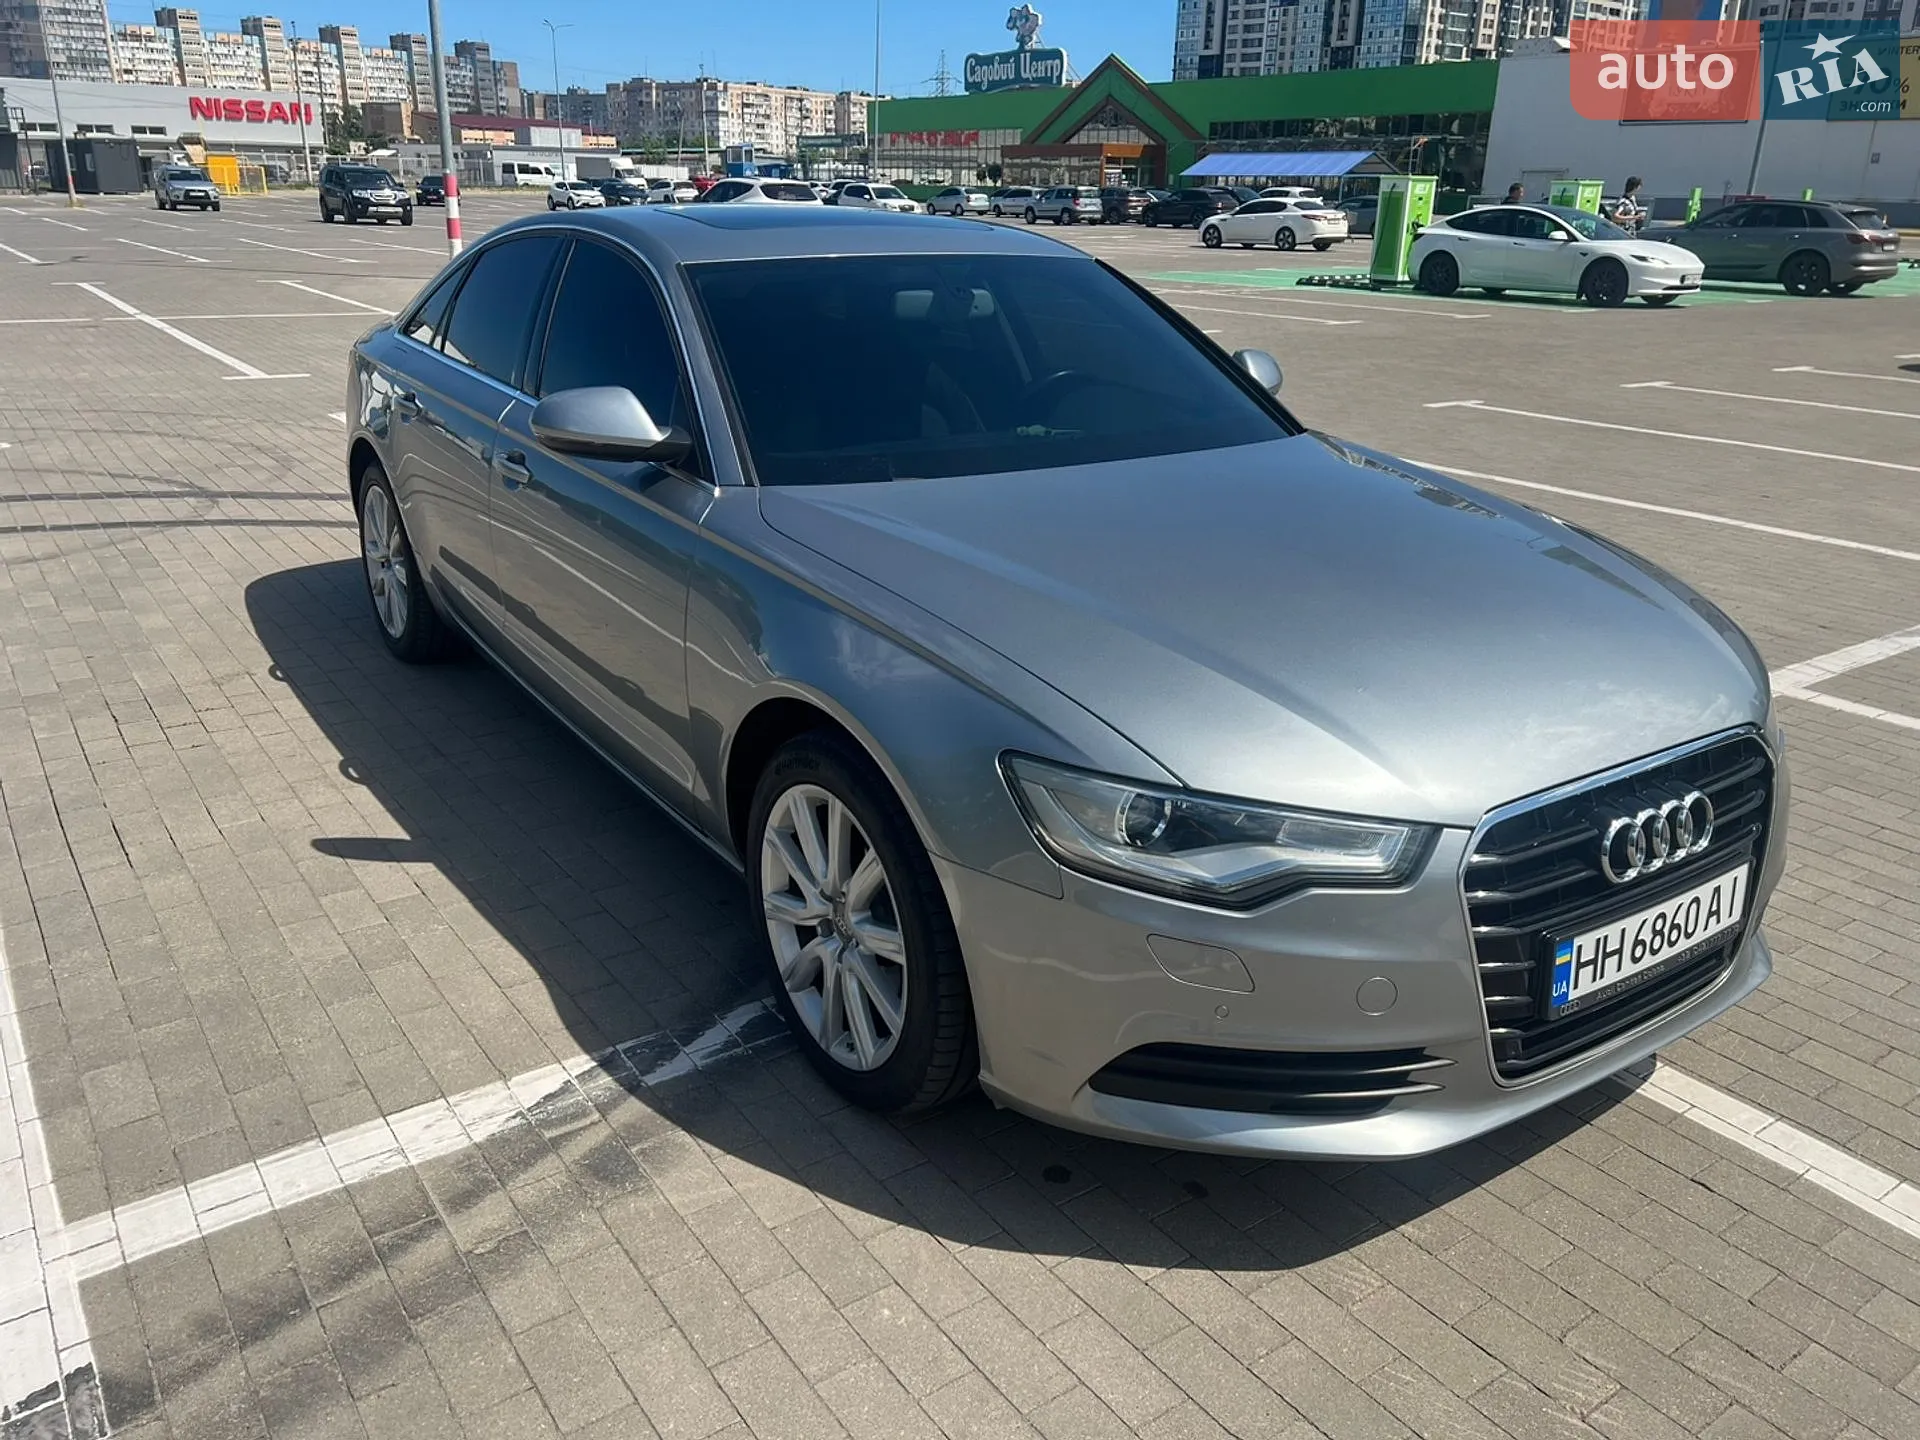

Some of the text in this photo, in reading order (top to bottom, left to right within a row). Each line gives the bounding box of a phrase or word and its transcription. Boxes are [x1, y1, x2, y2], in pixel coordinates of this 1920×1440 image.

[966, 52, 1061, 90] Садовий Центр
[189, 96, 312, 125] NISSAN
[1552, 983, 1568, 997] UA
